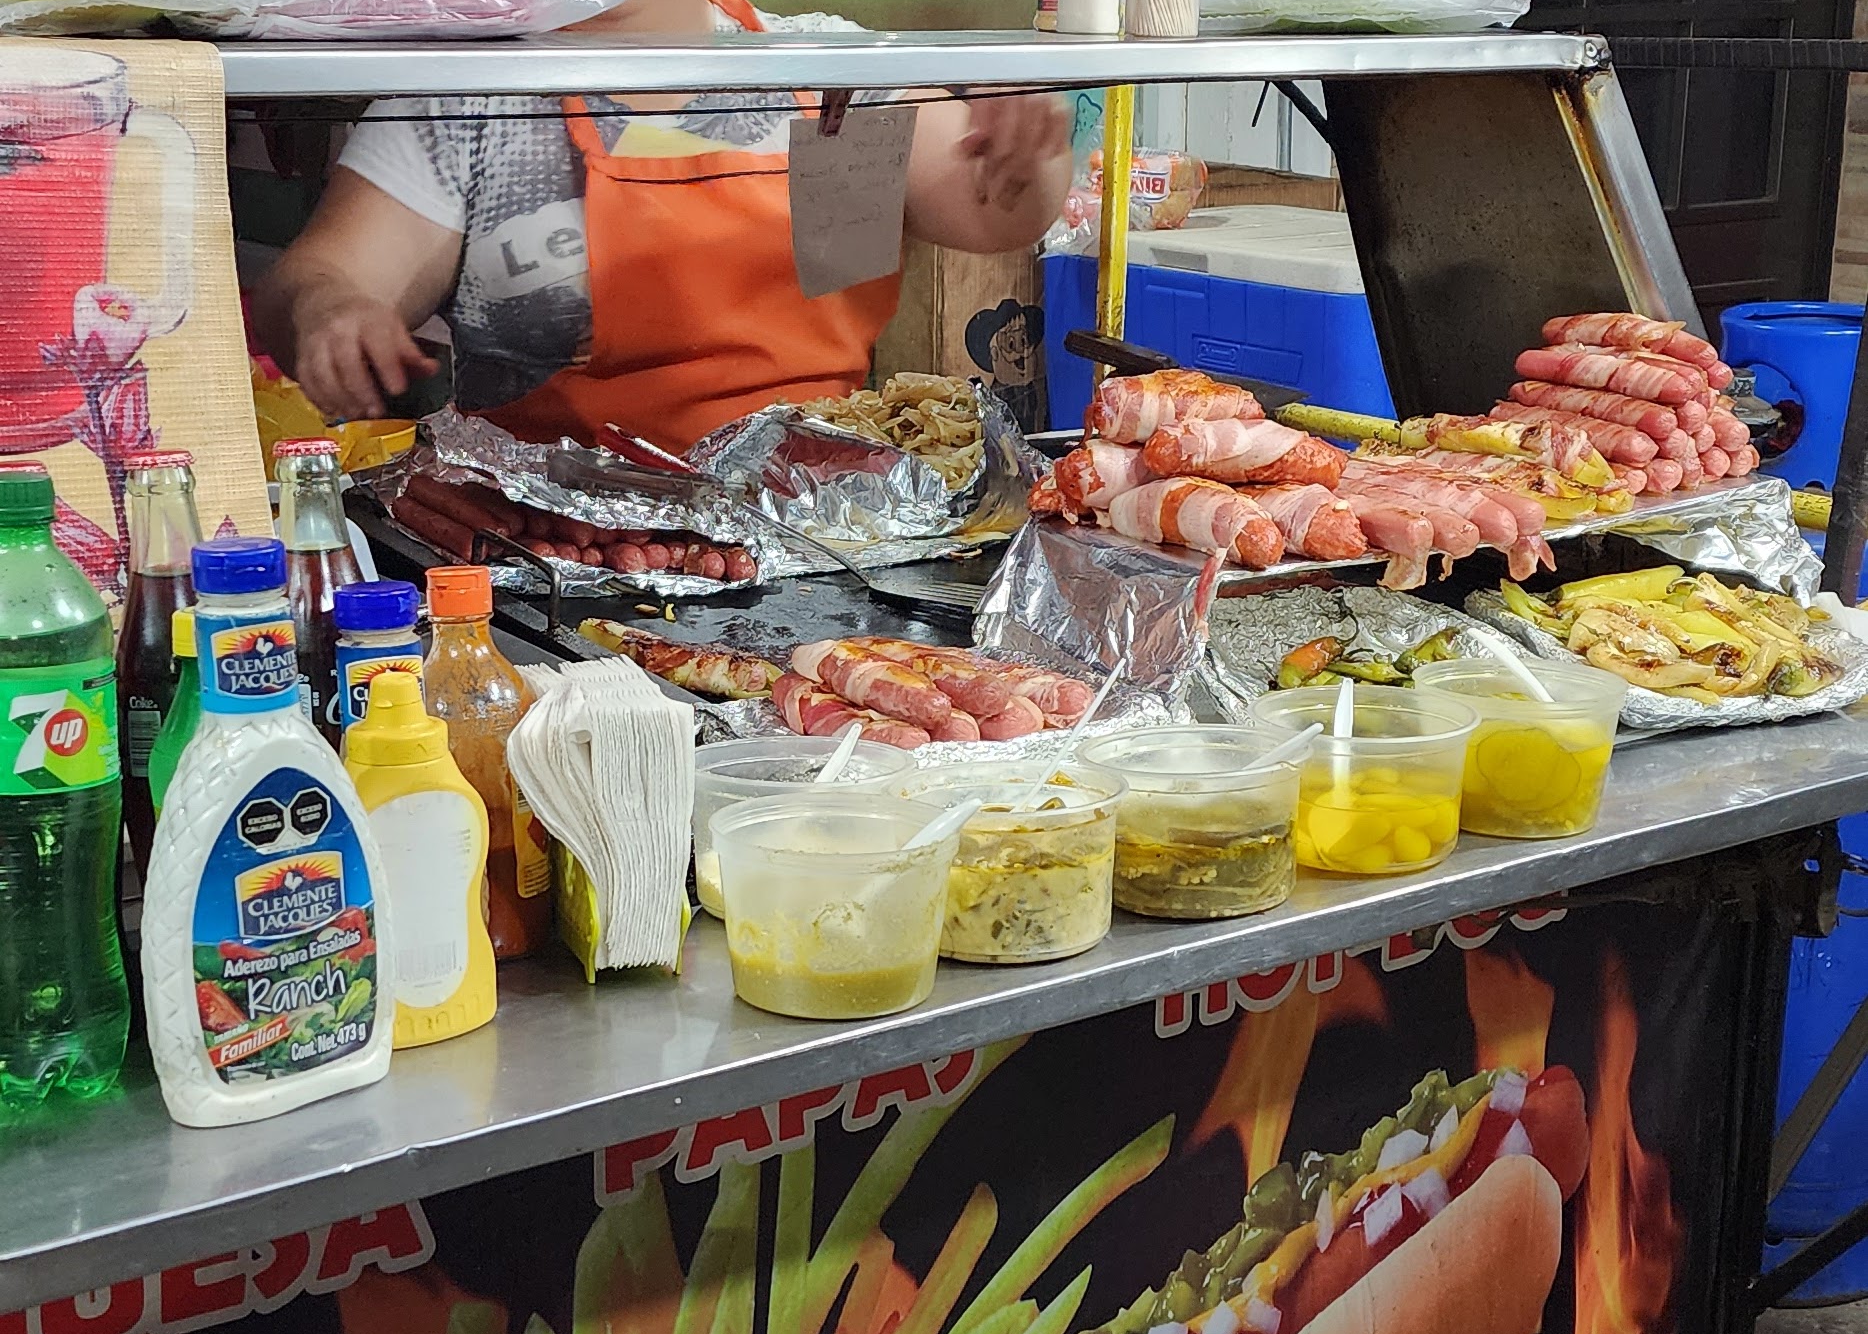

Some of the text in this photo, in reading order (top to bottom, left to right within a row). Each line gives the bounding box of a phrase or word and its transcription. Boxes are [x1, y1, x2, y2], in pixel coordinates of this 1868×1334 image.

[220, 649, 298, 675] CLEMENTE
[247, 881, 338, 916] CLEMENTE
[258, 902, 334, 935] JACQUES
[223, 929, 361, 978] Aderezo para Ensaladas
[247, 960, 346, 1021] Ranch
[220, 1022, 283, 1063] Familiar
[336, 1022, 358, 1046] 473
[358, 1021, 368, 1042] g
